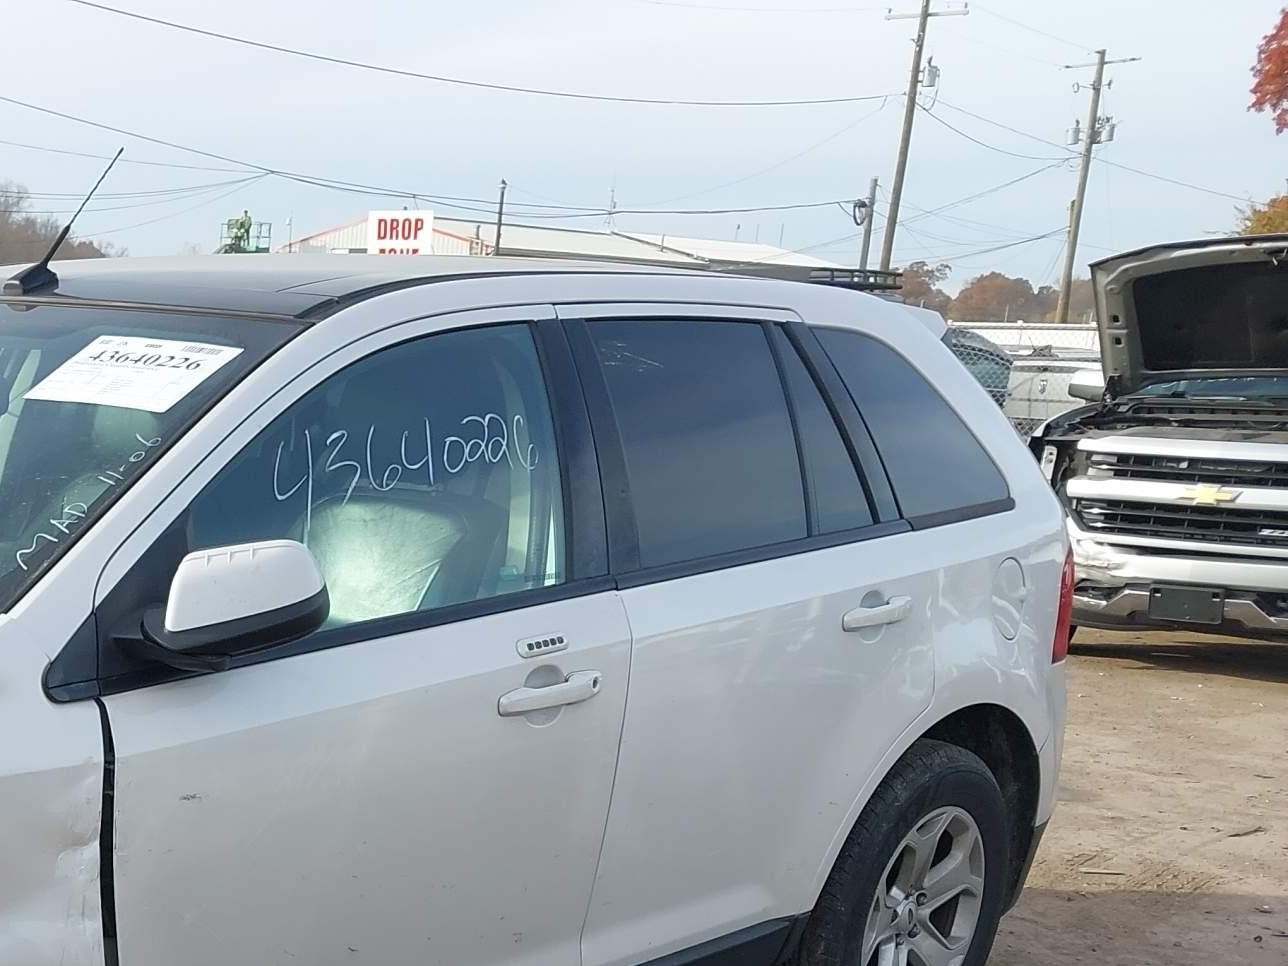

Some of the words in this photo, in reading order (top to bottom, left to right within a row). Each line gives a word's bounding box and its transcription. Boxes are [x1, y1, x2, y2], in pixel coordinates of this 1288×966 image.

[377, 218, 424, 240] DROP
[89, 349, 204, 371] 43640226
[274, 413, 539, 530] 43640226
